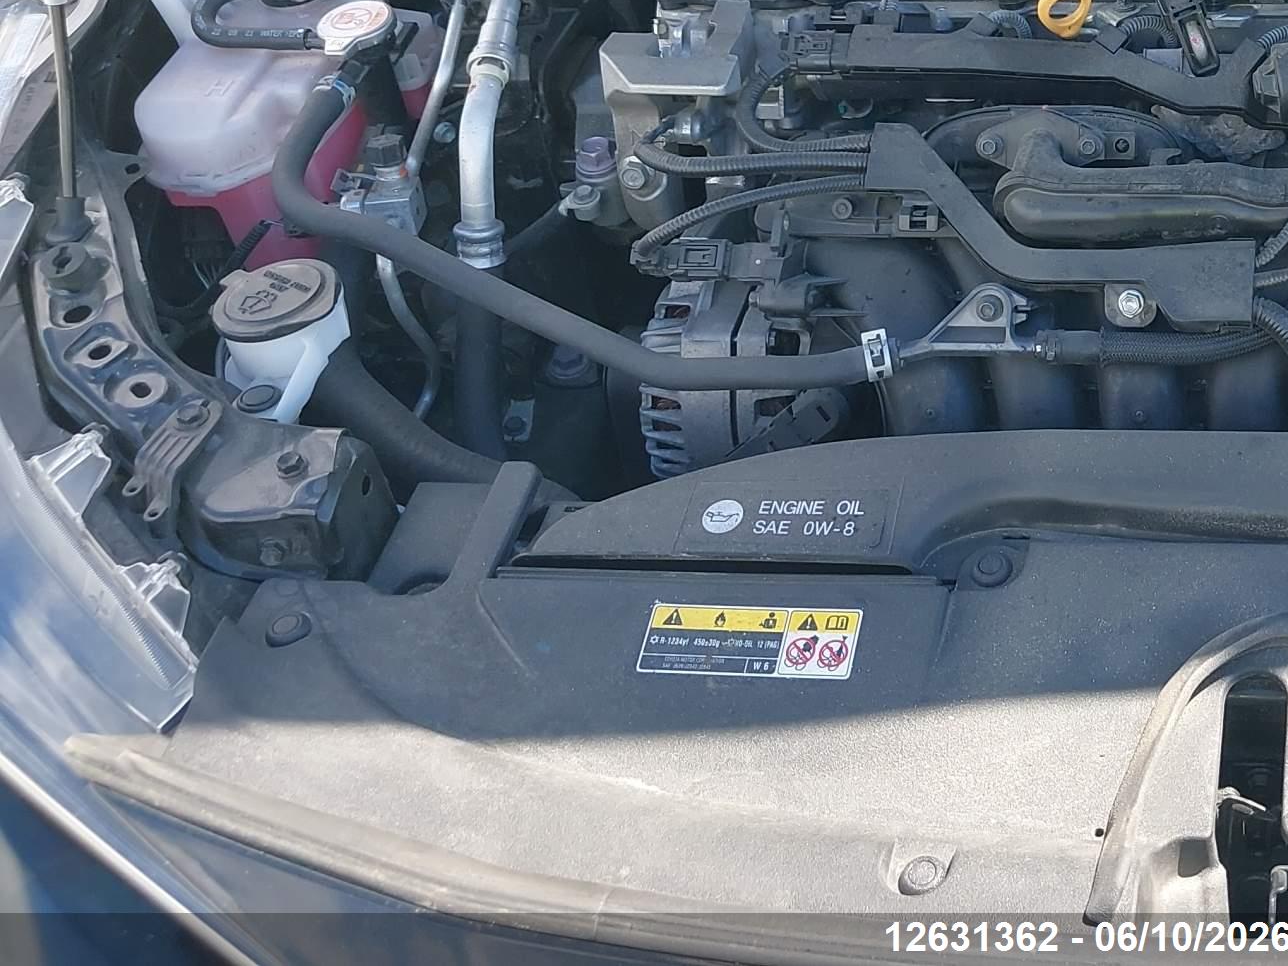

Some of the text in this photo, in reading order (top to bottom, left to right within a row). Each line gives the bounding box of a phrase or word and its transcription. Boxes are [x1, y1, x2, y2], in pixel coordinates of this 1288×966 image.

[758, 500, 865, 515] ENGINE OIL
[752, 520, 855, 536] SAE 0W-8
[660, 636, 690, 647] R-1234yf
[753, 662, 770, 670] W 6
